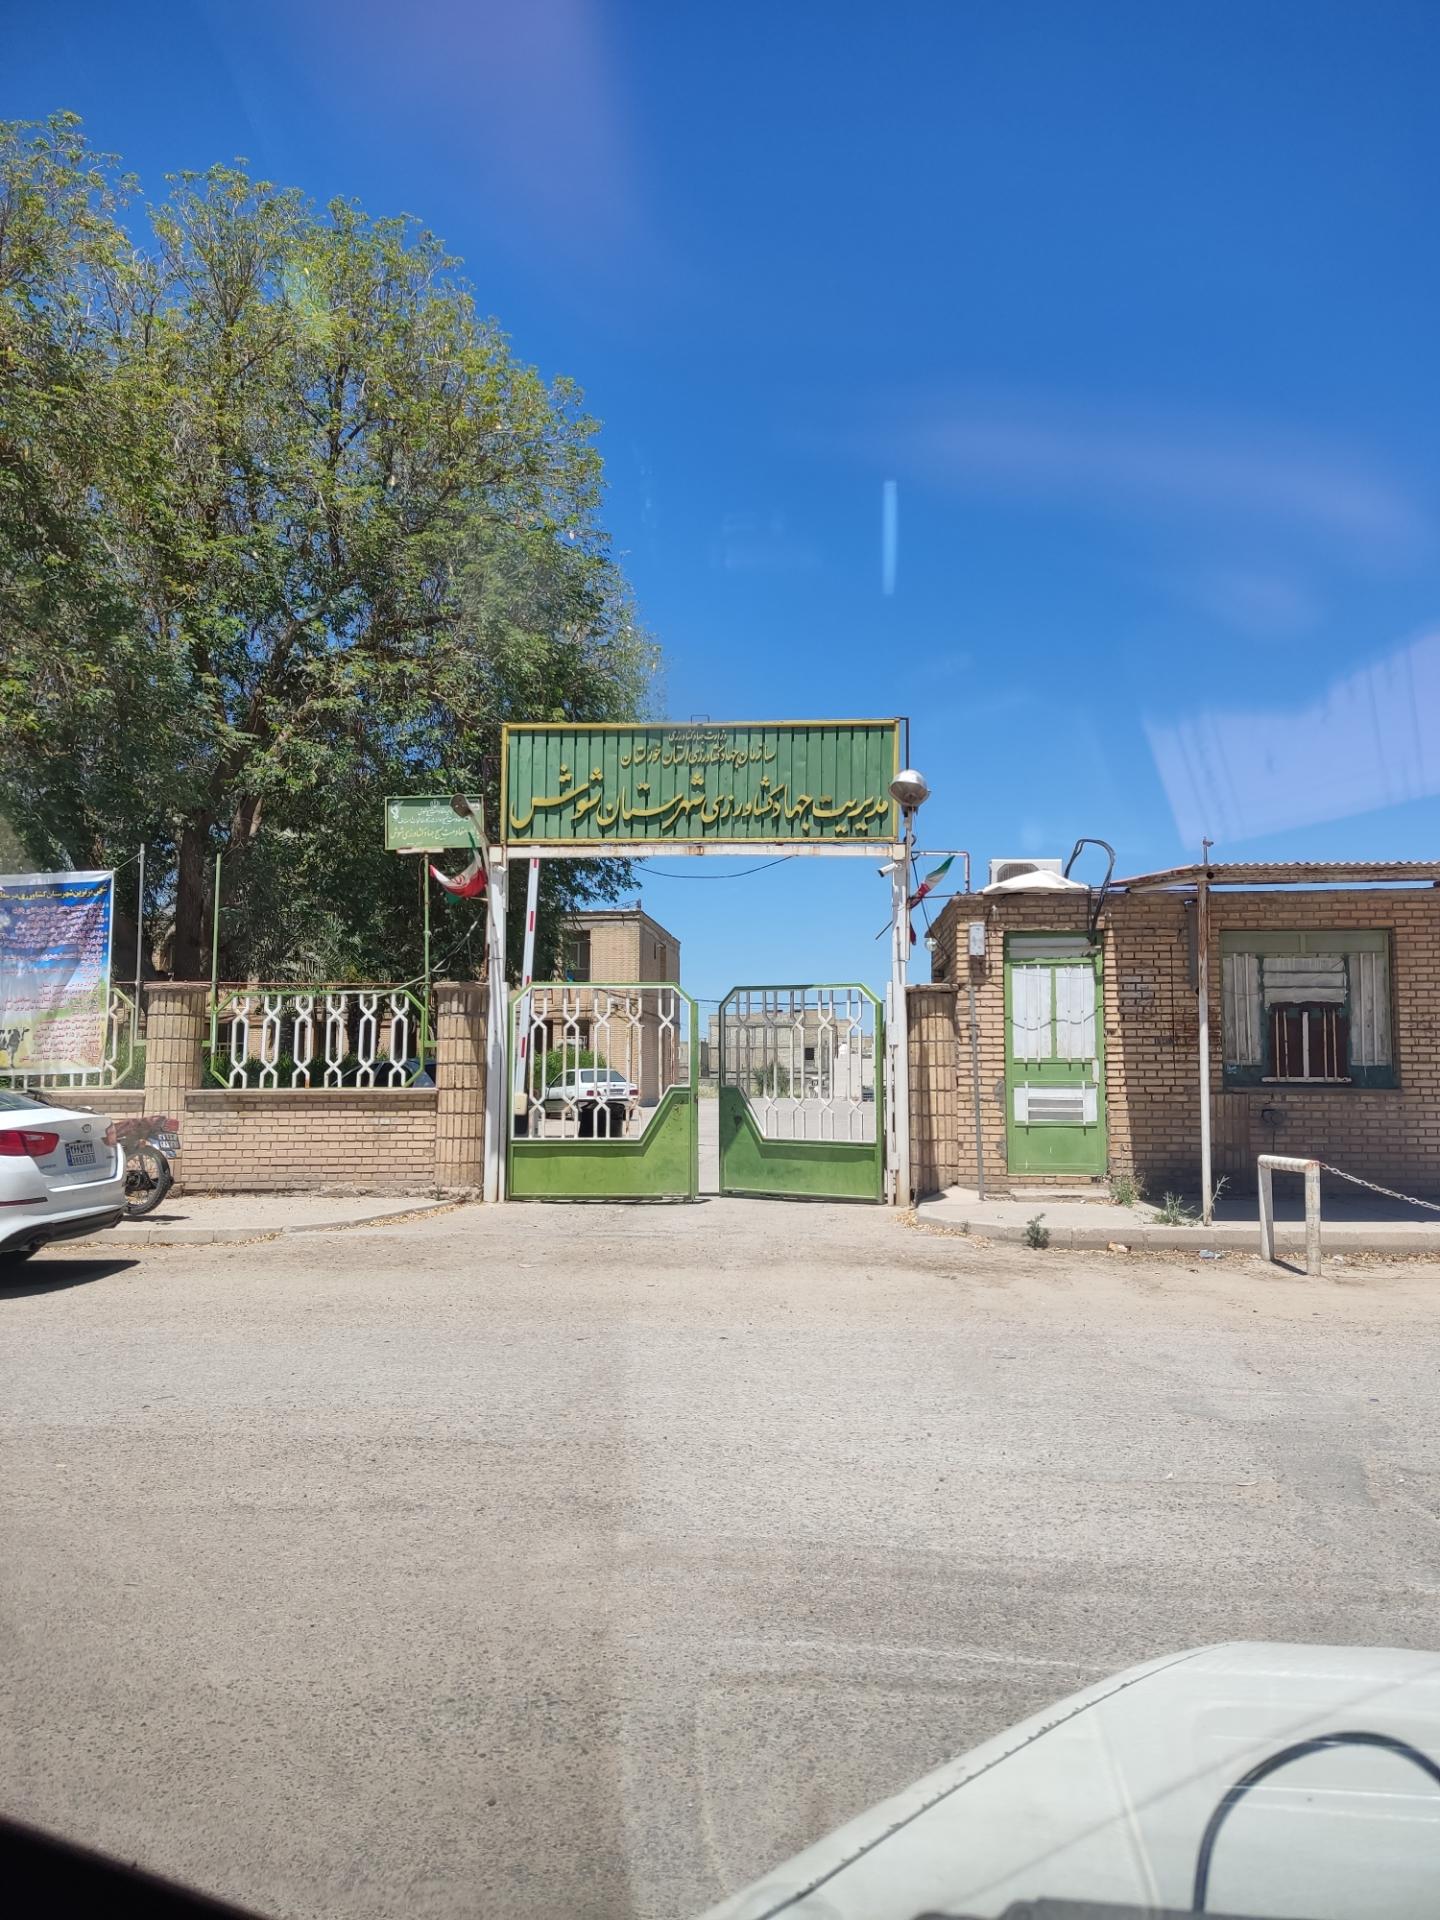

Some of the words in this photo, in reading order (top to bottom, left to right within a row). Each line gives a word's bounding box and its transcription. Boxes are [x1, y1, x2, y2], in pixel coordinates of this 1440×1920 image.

[707, 730, 728, 742] وزارت
[620, 744, 662, 766] خوزستان
[661, 746, 689, 765] استان
[688, 745, 724, 765] کشاورزی
[720, 747, 739, 768] جهاد
[737, 744, 777, 767] سازمان
[510, 764, 604, 829] شوش
[596, 772, 706, 830] شهرستان
[701, 776, 785, 823] کشاورزی
[771, 784, 814, 830] جهاد
[812, 795, 889, 832] مدیریت
